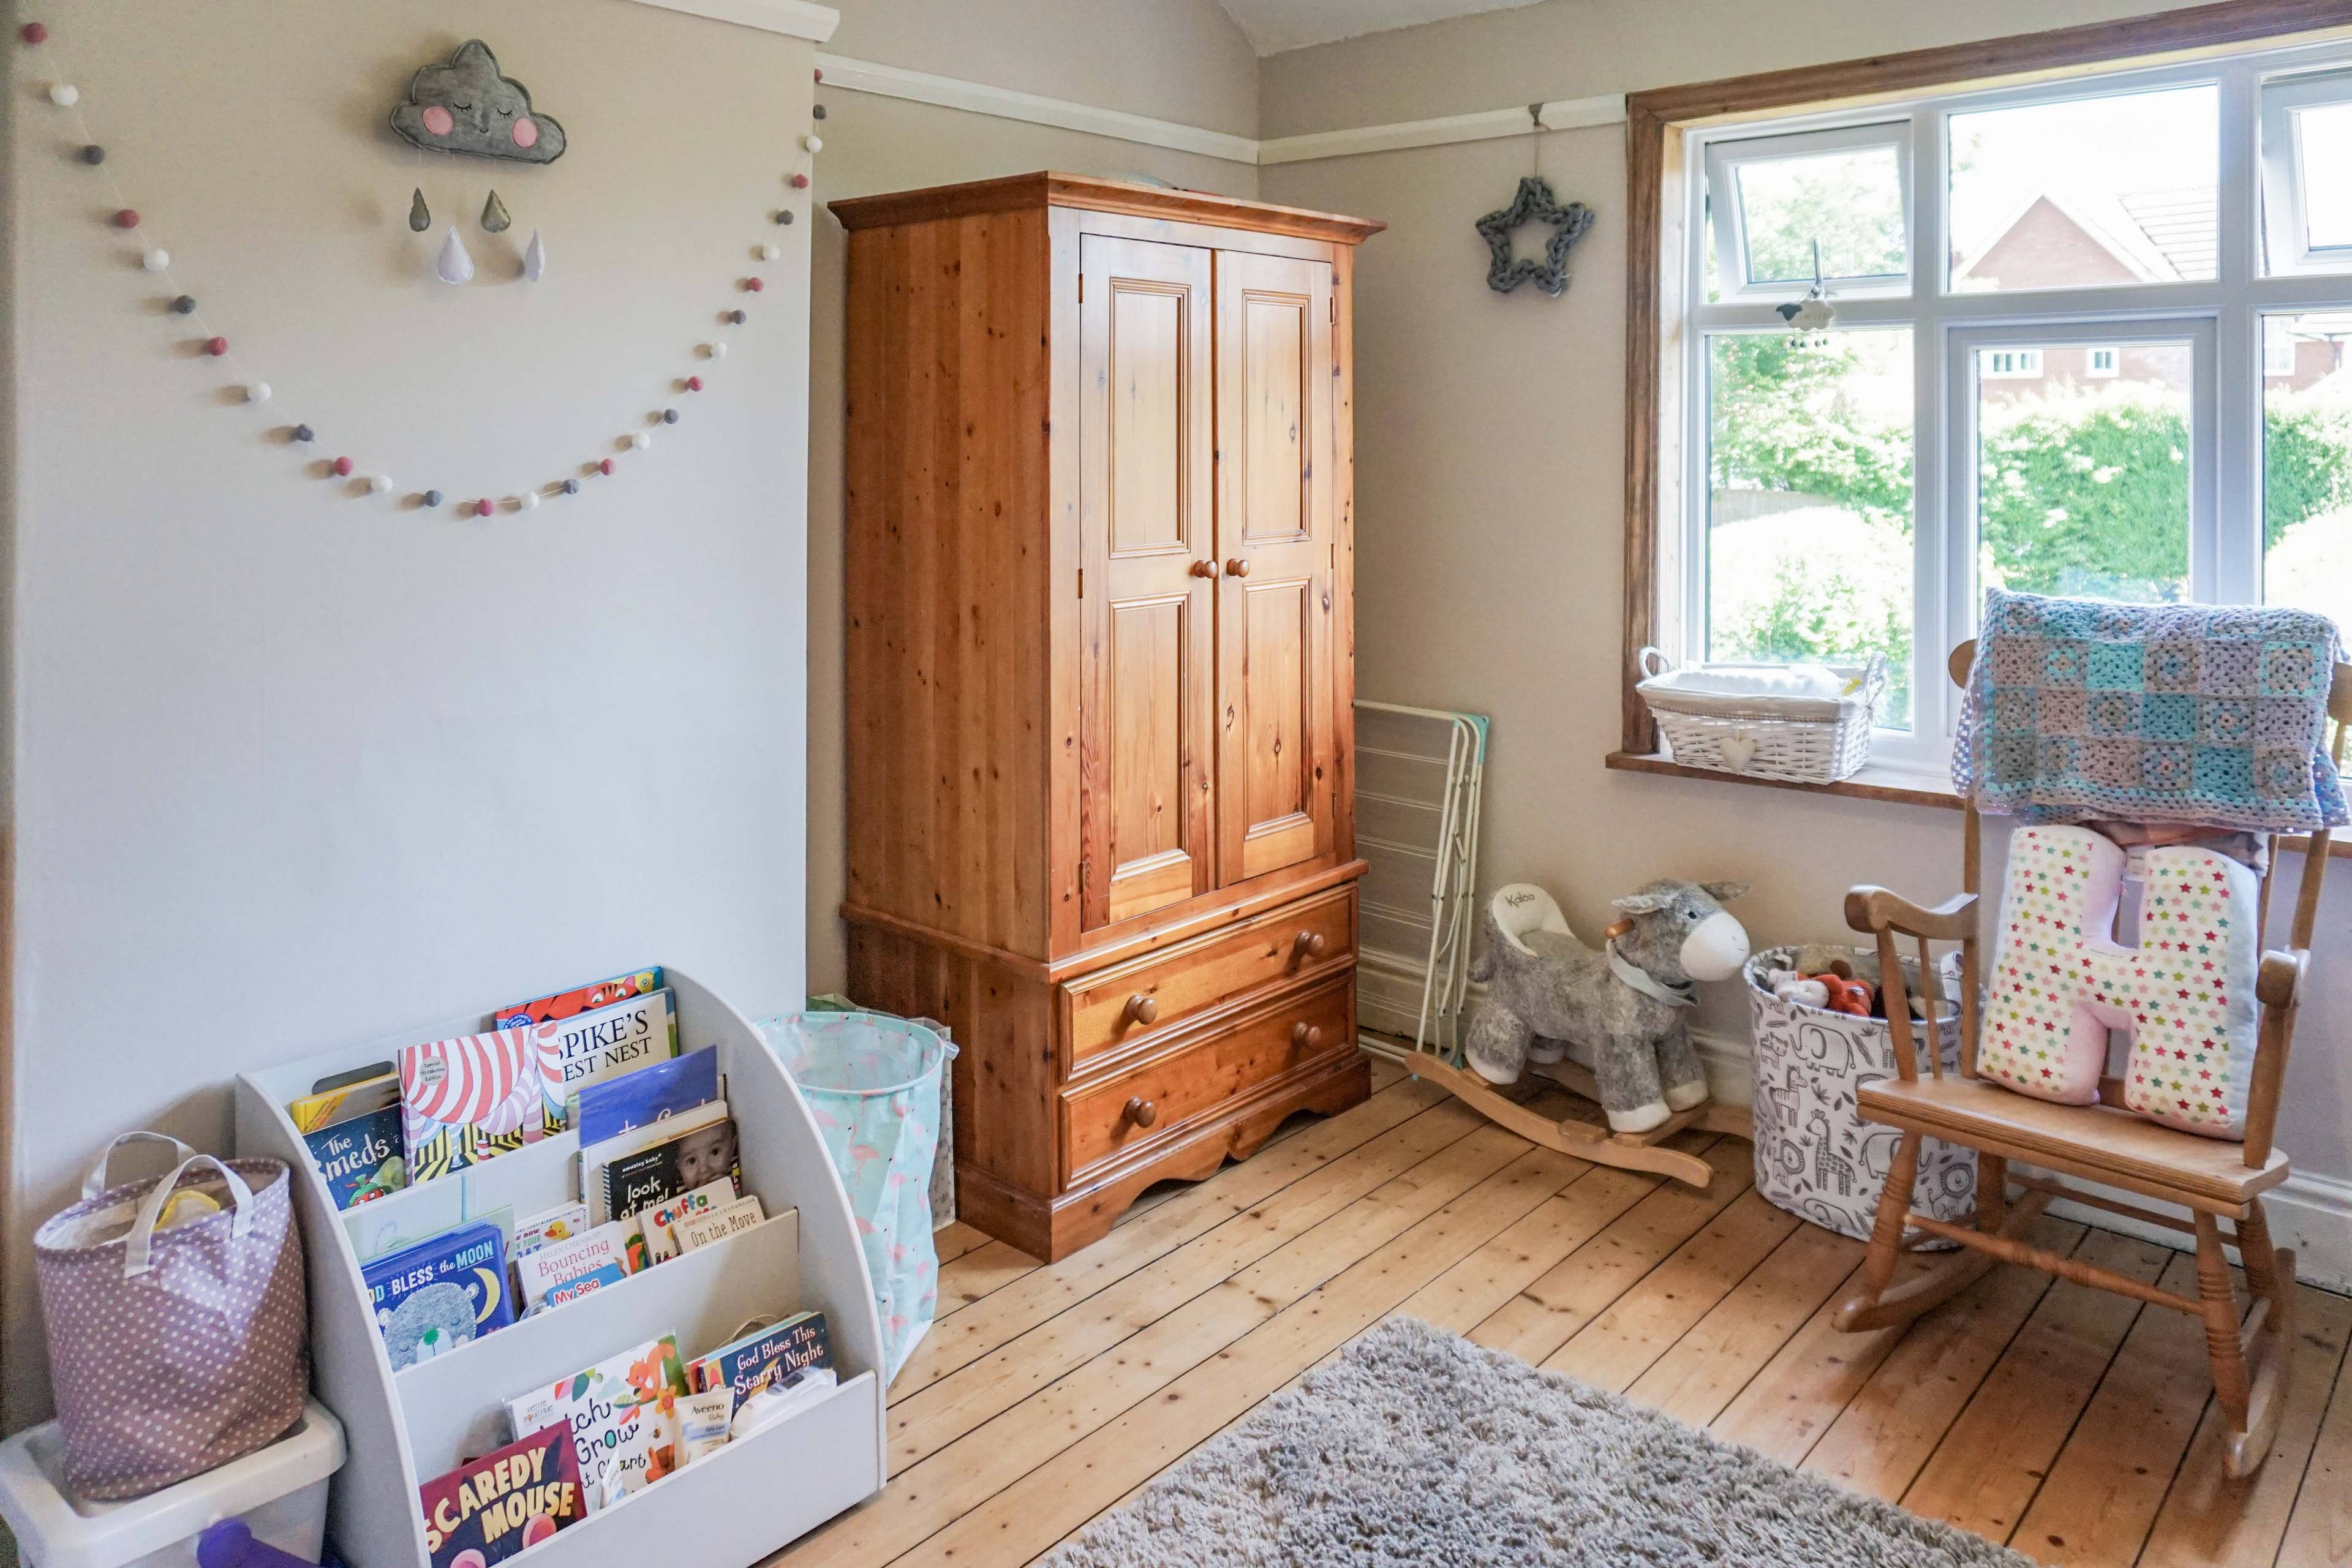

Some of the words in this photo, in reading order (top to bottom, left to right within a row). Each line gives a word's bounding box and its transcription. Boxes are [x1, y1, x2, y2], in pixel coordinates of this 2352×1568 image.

[1504, 891, 1535, 908] Kaloo
[563, 1055, 597, 1082] EST
[605, 1037, 652, 1068] NEST
[321, 1134, 353, 1156] The
[622, 1161, 644, 1172] amazing
[627, 1176, 662, 1203] look
[620, 1204, 638, 1220] at
[654, 1194, 709, 1228] Chuffa
[523, 1234, 541, 1247] YOUR
[524, 1228, 540, 1238] ROW
[691, 1232, 707, 1247] On
[709, 1223, 728, 1240] the
[728, 1213, 756, 1232] Move
[516, 1243, 541, 1258] OAT
[538, 1240, 609, 1277] Bouncing
[540, 1247, 564, 1261] HELEN
[565, 1231, 602, 1250] OXENBURY
[368, 1284, 385, 1303] OD
[391, 1265, 434, 1296] BLESS
[439, 1259, 456, 1273] the
[455, 1240, 494, 1269] MOON
[555, 1289, 574, 1304] My
[575, 1279, 600, 1295] Sea
[737, 1348, 759, 1371] God
[762, 1339, 791, 1359] Bless
[793, 1326, 816, 1345] This
[734, 1363, 782, 1395] Starry
[785, 1341, 823, 1371] Night
[692, 1403, 724, 1415] Aveeno
[709, 1412, 725, 1421] Baby
[575, 1424, 639, 1465] Grow
[598, 1453, 646, 1479] Cart
[424, 1447, 547, 1554] SCAREDY
[480, 1482, 575, 1544] MOUSE
